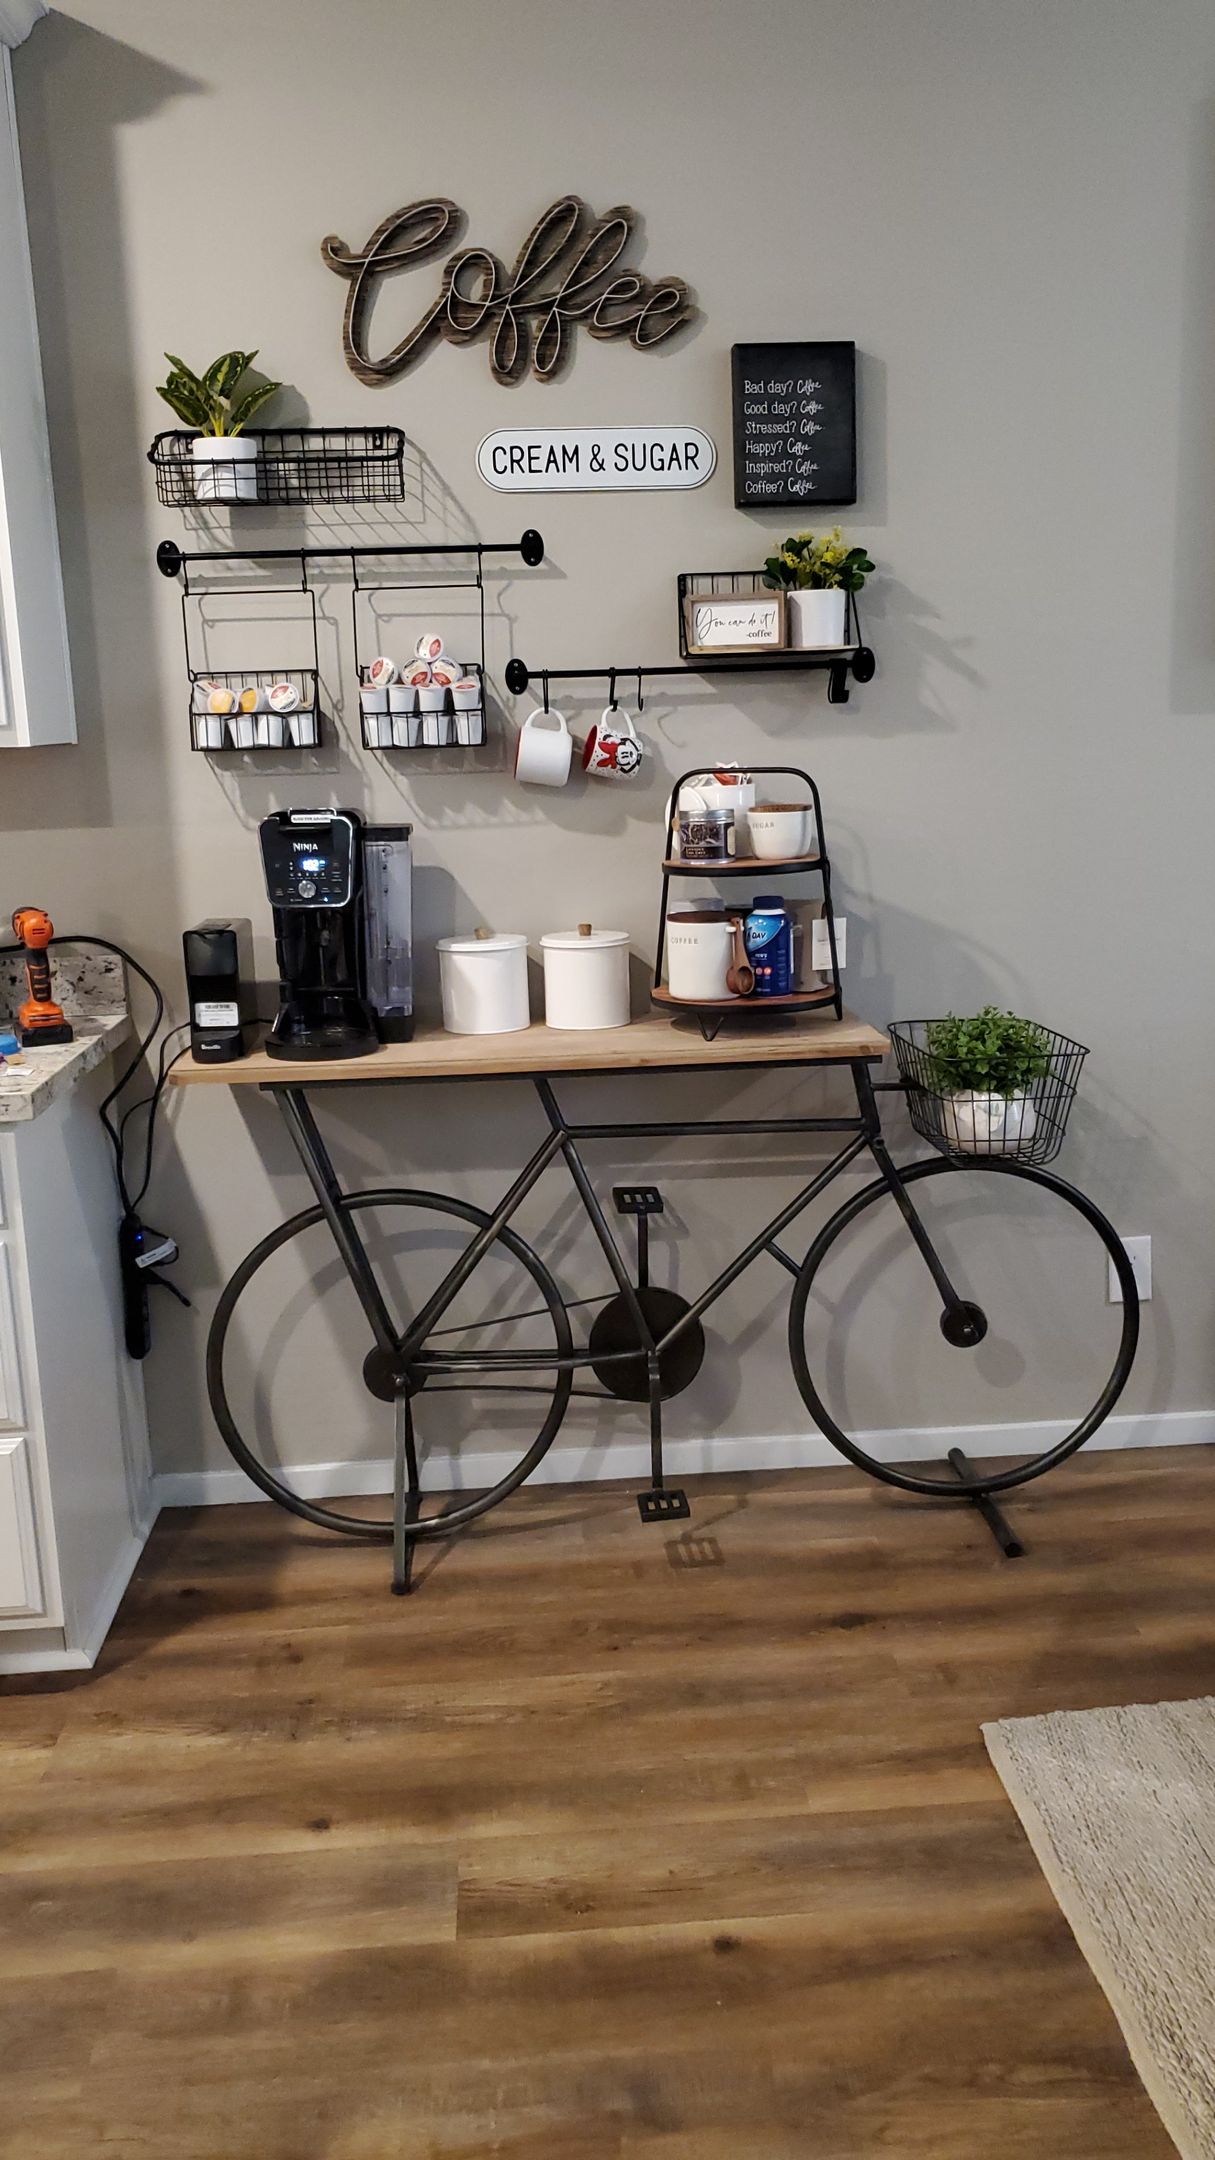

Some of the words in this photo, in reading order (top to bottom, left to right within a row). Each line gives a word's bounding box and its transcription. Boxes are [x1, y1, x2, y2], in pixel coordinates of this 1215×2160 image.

[320, 195, 696, 389] Coffee
[744, 380, 764, 394] Bad
[767, 380, 794, 396] day?
[744, 401, 768, 415] Good
[771, 401, 797, 417] day?
[745, 421, 797, 434] Stressed?
[745, 440, 783, 457] Happy?
[492, 444, 580, 475] CREAM
[589, 443, 606, 473] &
[614, 442, 699, 472] SUGAR
[745, 460, 793, 476] Inspired?
[745, 480, 784, 494] Coffee?
[695, 607, 725, 641] You
[728, 619, 746, 627] can
[748, 612, 756, 627] do
[752, 931, 767, 940] DAY
